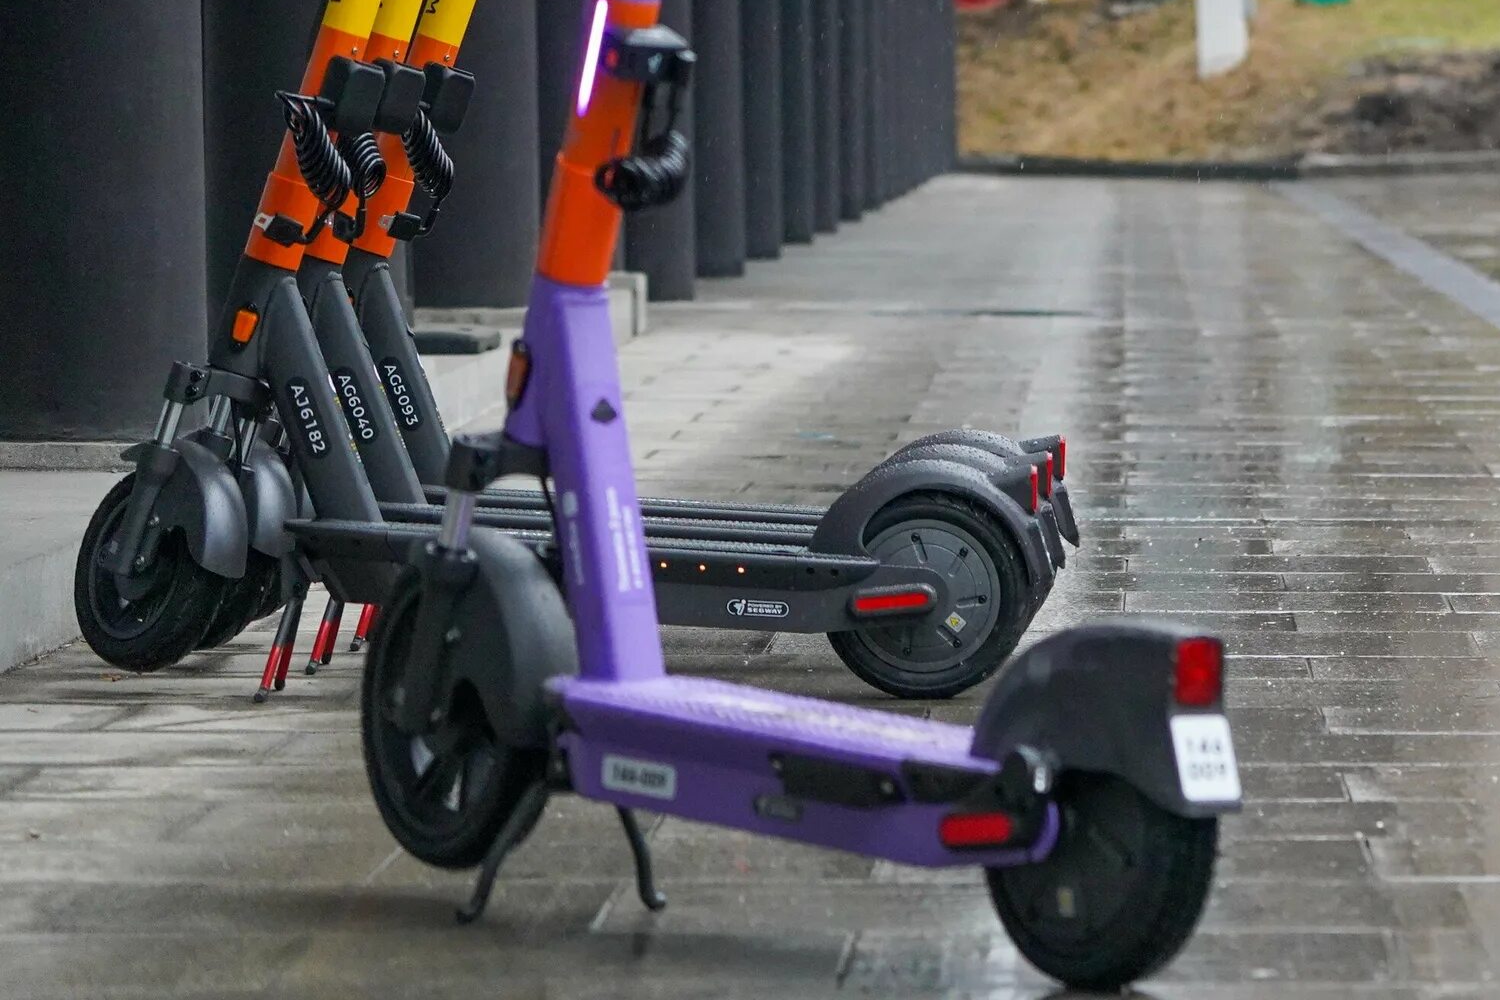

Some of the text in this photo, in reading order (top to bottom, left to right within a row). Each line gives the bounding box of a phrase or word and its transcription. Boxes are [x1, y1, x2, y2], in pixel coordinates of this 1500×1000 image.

[290, 384, 326, 454] AJ6182
[338, 375, 374, 440] AG6040
[384, 364, 419, 426] AG5093
